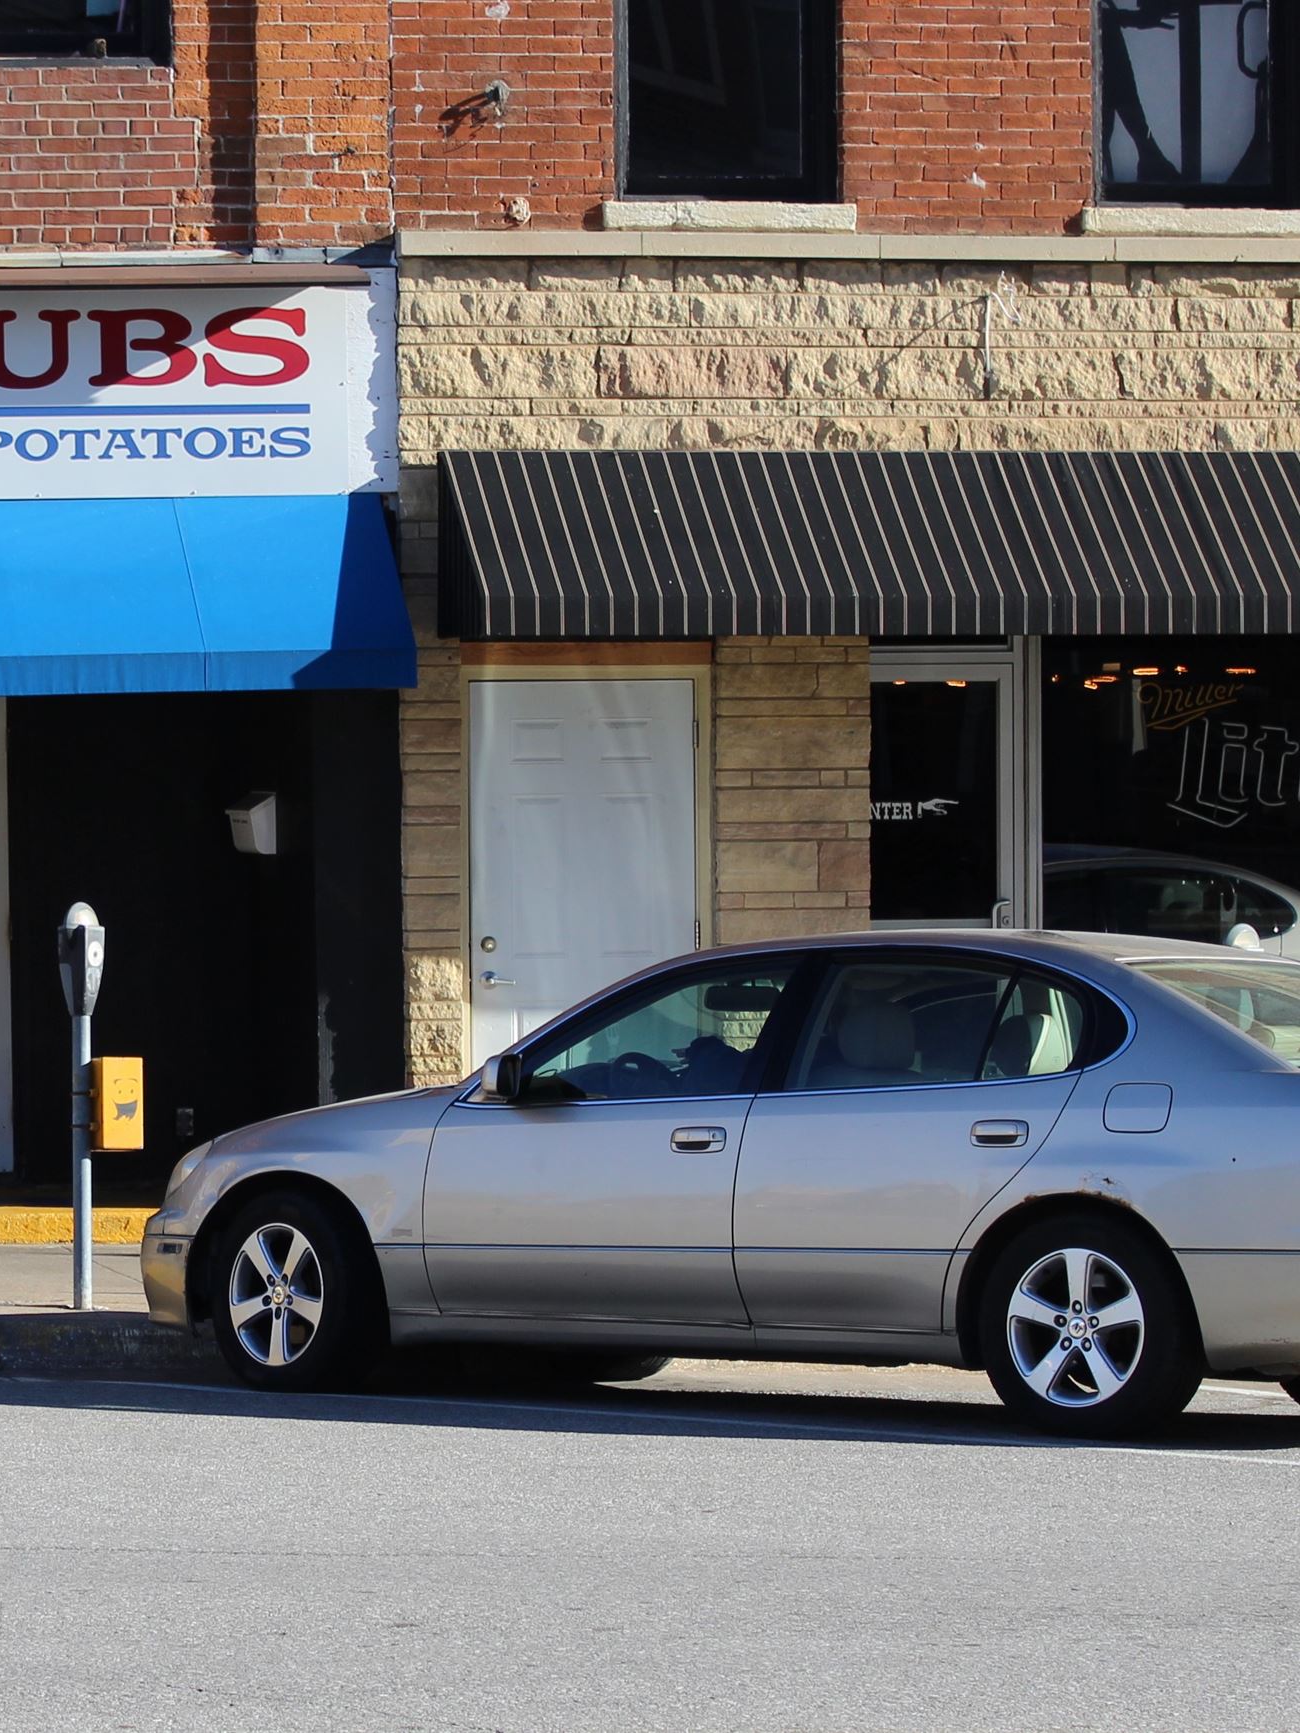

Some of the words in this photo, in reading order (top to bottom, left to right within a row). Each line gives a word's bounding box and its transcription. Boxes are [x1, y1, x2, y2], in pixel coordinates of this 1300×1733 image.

[1138, 683, 1244, 719] Miller
[1166, 716, 1300, 828] Lit
[870, 802, 913, 820] NTER
